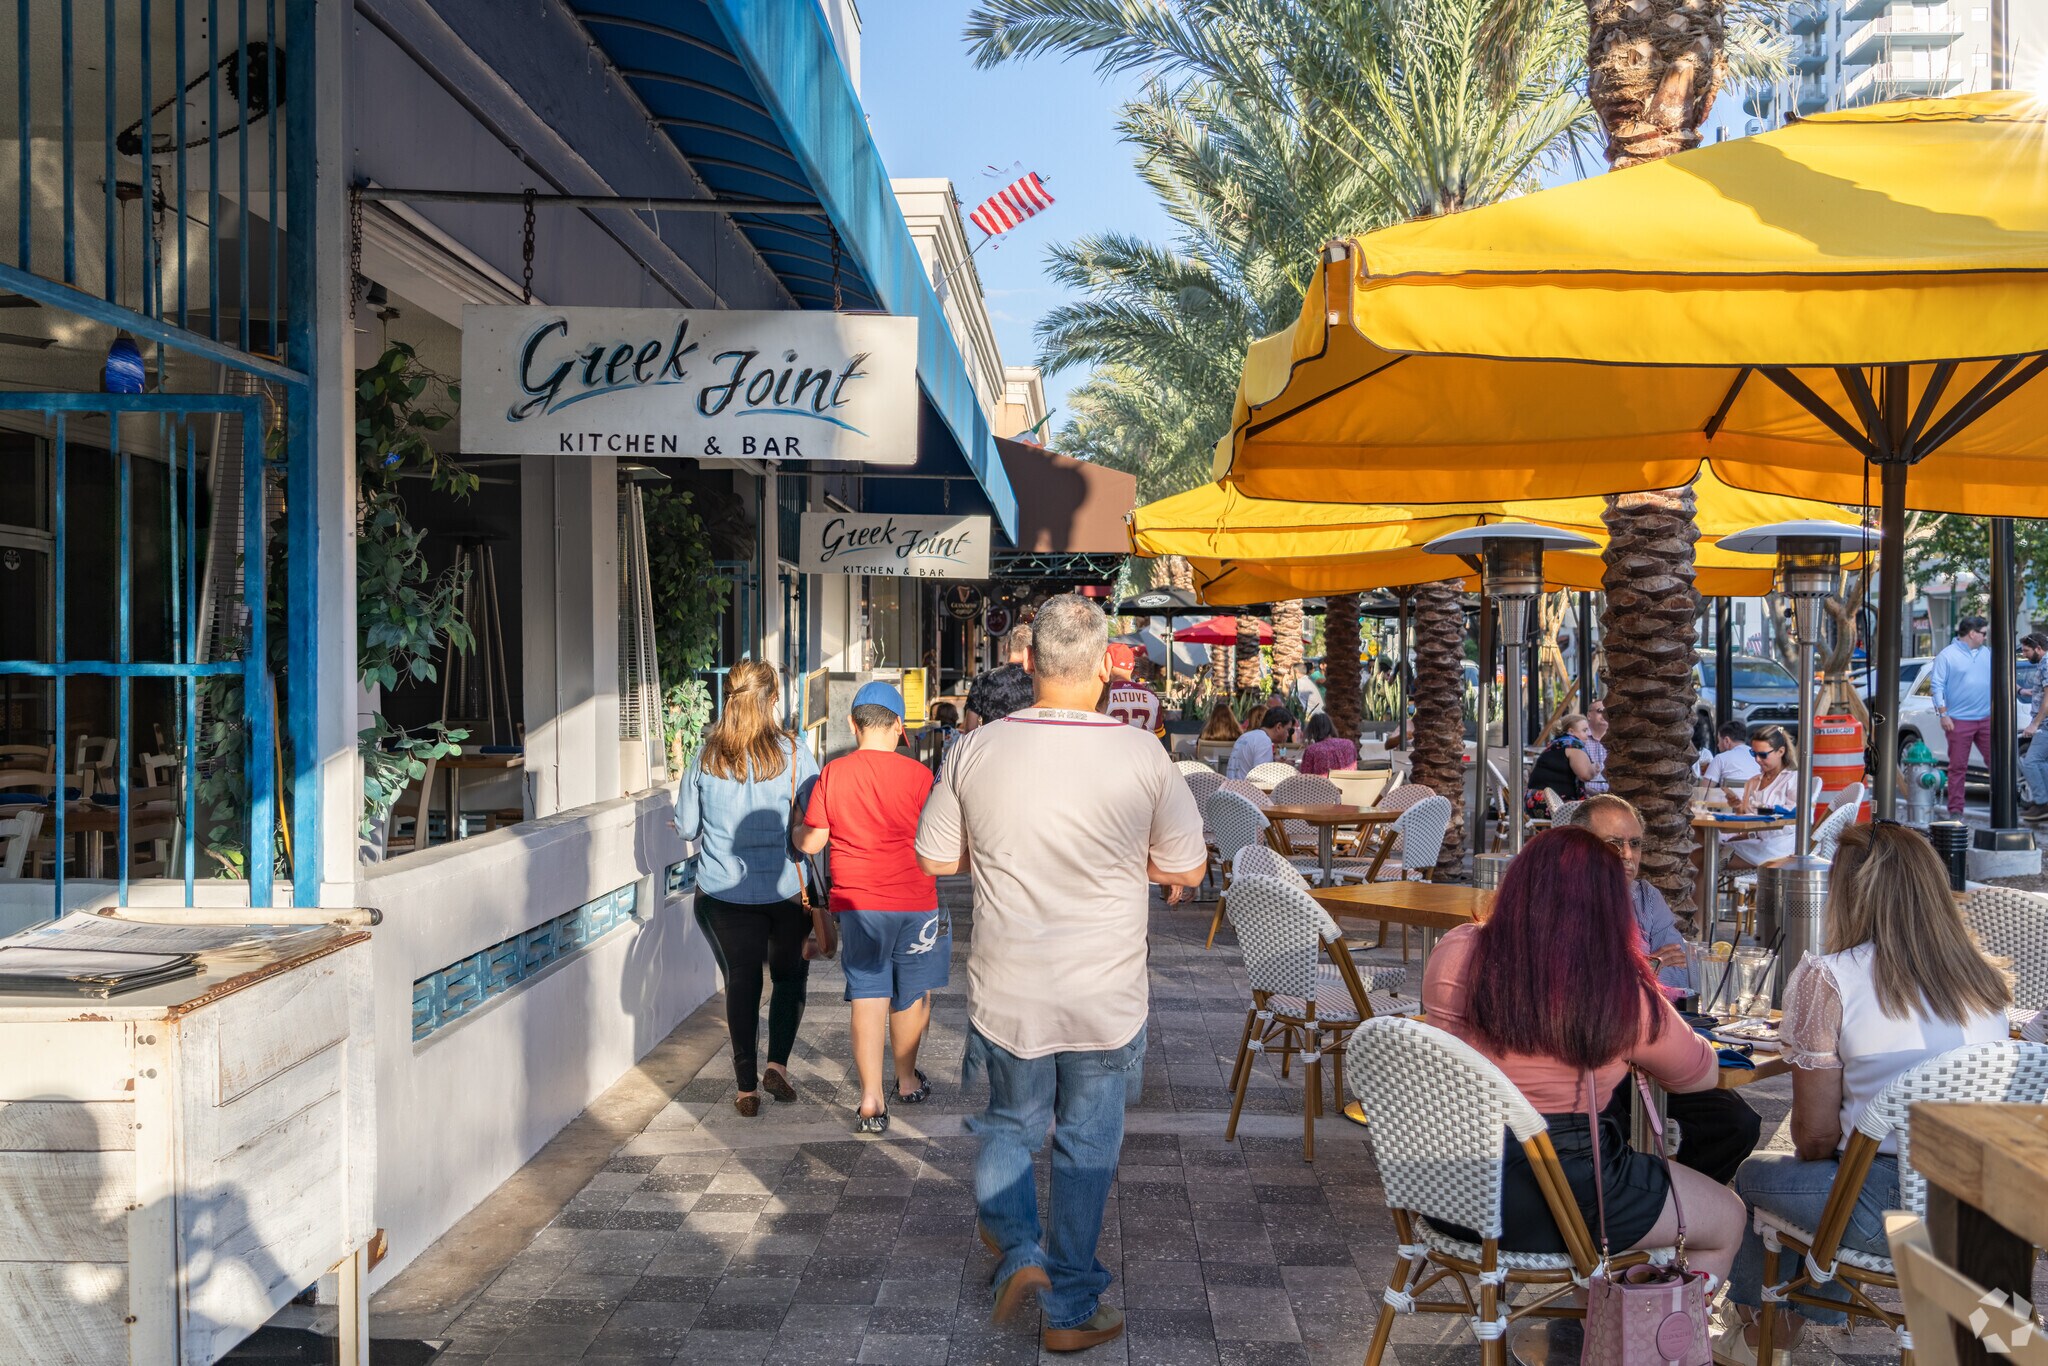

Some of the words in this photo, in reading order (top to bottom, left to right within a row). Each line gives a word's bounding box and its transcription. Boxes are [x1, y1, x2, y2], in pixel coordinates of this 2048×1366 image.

[507, 316, 699, 422] Greek
[697, 350, 871, 418] Joint
[560, 432, 677, 453] KITCHEN
[704, 436, 722, 455] &
[742, 436, 803, 457] BAR
[820, 517, 897, 562] Greek
[896, 529, 972, 559] Joint
[843, 565, 894, 575] KITCHEN
[903, 567, 910, 576] &
[919, 568, 944, 577] BAR
[1112, 692, 1148, 703] ALTUVE
